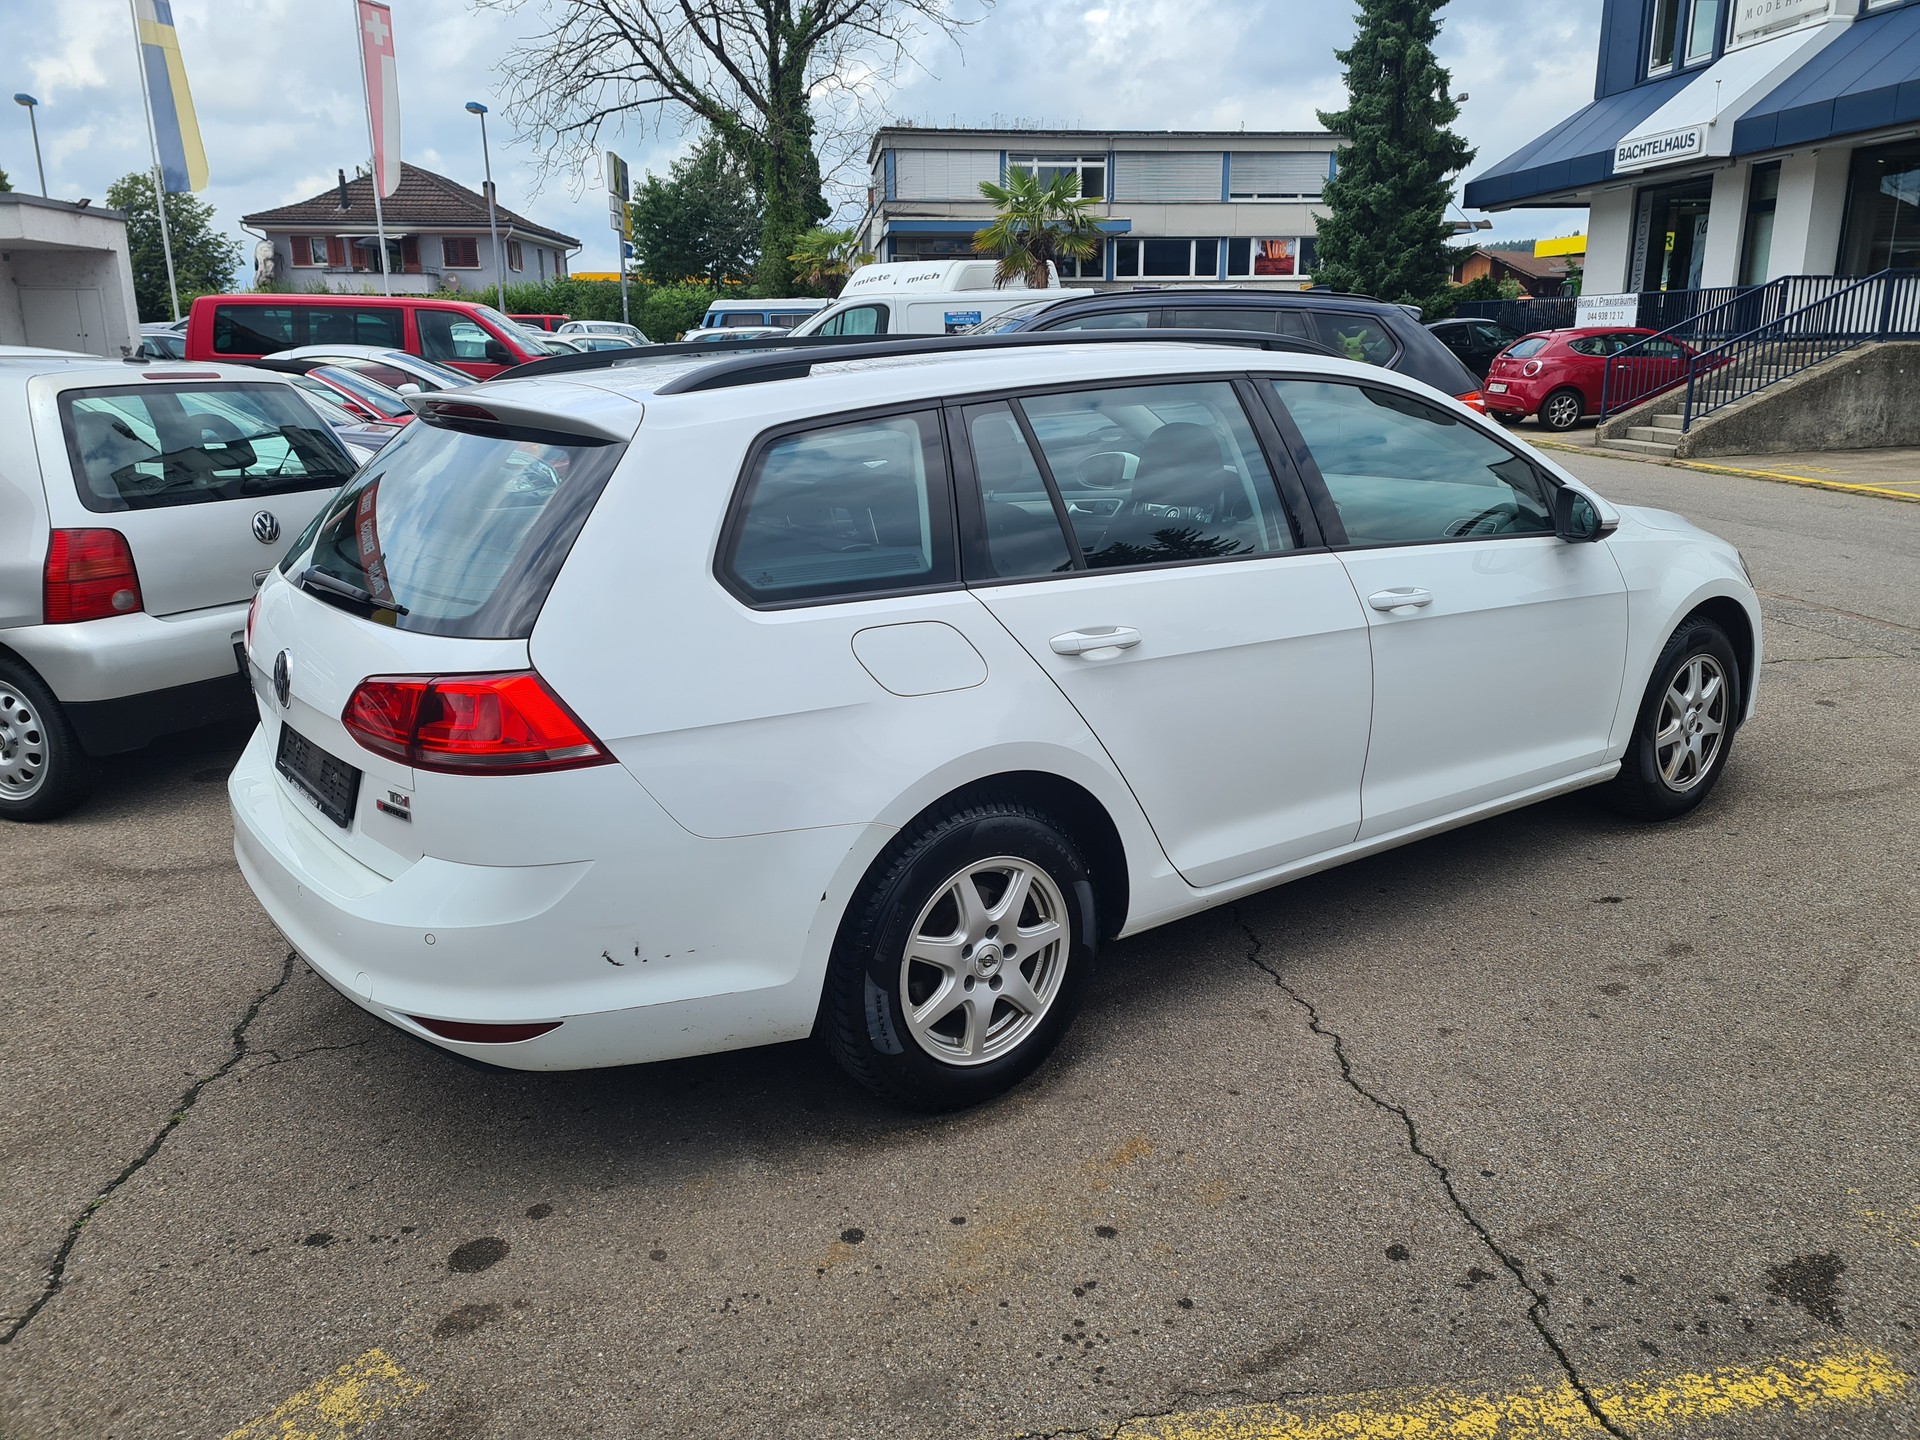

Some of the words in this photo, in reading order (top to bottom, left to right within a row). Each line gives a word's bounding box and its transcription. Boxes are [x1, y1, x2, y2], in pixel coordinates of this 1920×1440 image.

[1744, 0, 1802, 21] MODEH
[1618, 132, 1696, 162] BACHTELHAUS
[1633, 203, 1648, 293] AMENMODE
[853, 273, 891, 287] miete
[906, 272, 941, 284] mich
[1578, 297, 1594, 307] Büros
[1599, 296, 1637, 307] Praxisräume
[1587, 312, 1597, 320] 044
[1598, 311, 1608, 320] 938
[1609, 311, 1616, 320] 12
[1617, 311, 1624, 320] 12
[387, 790, 410, 809] TDI
[875, 993, 892, 1050] WINTER
